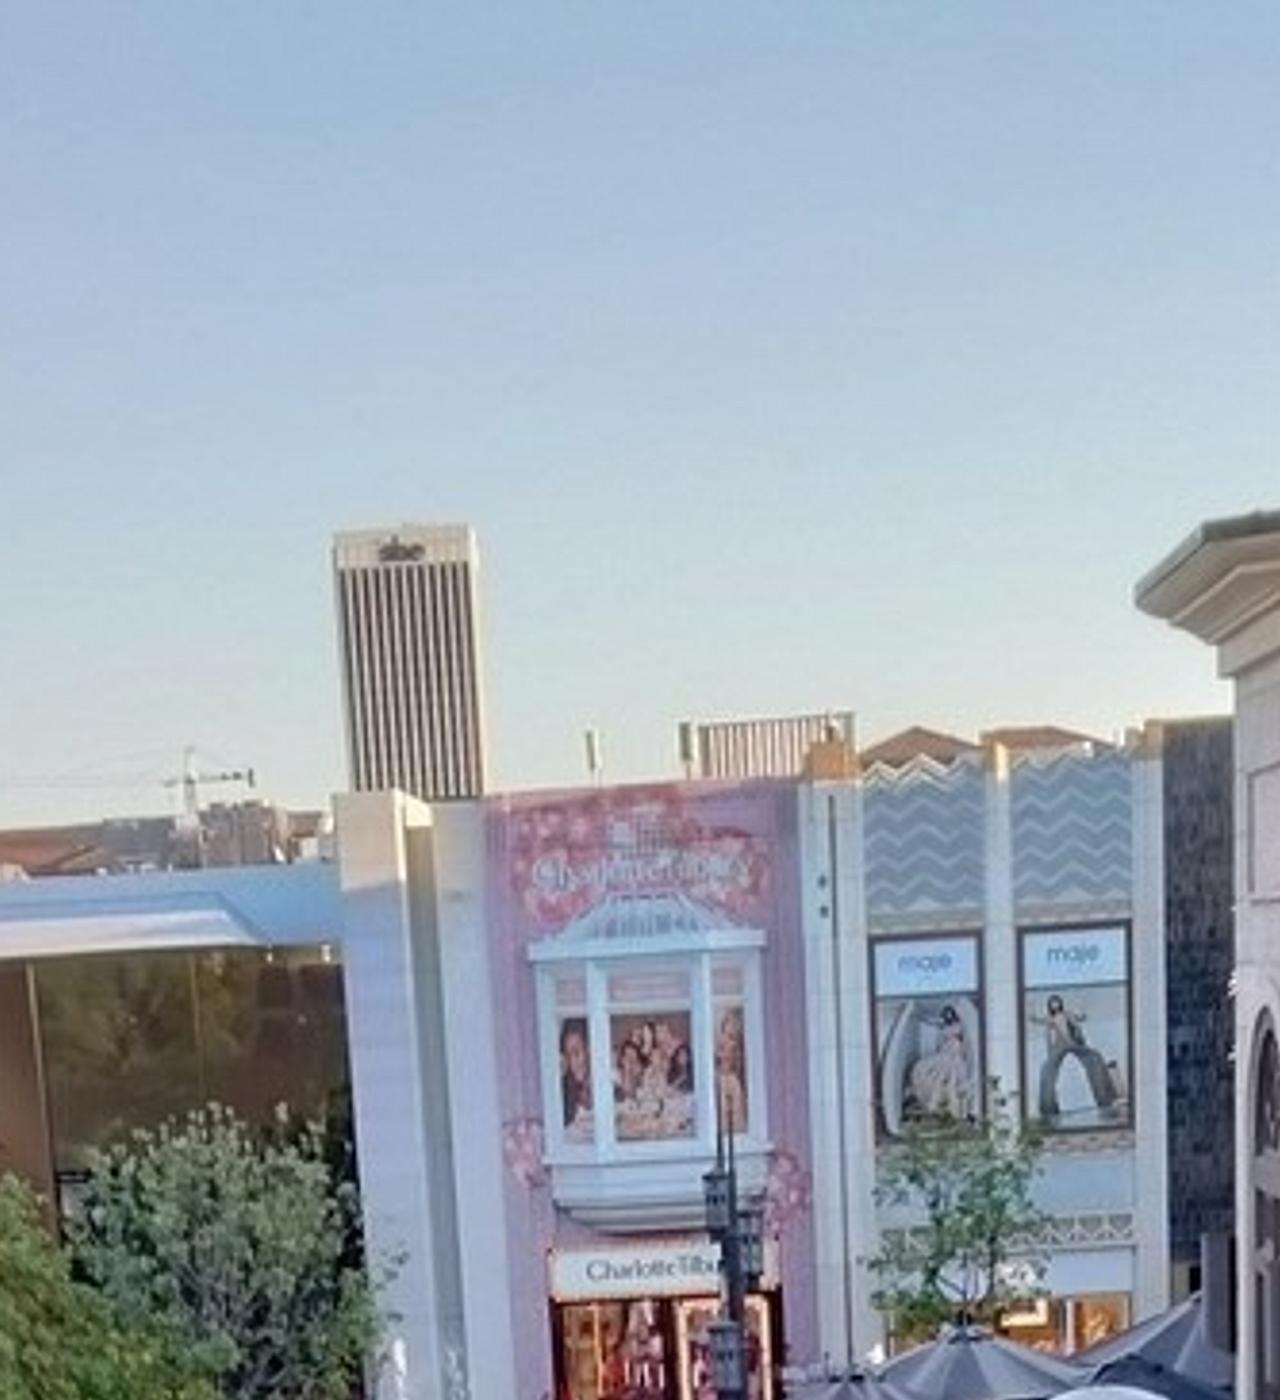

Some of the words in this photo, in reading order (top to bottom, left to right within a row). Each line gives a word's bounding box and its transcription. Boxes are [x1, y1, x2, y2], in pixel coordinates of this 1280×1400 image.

[897, 952, 953, 974] maje
[1047, 944, 1101, 967] maje
[585, 1258, 676, 1281] Charlotte
[677, 1253, 717, 1275] Tilbu
